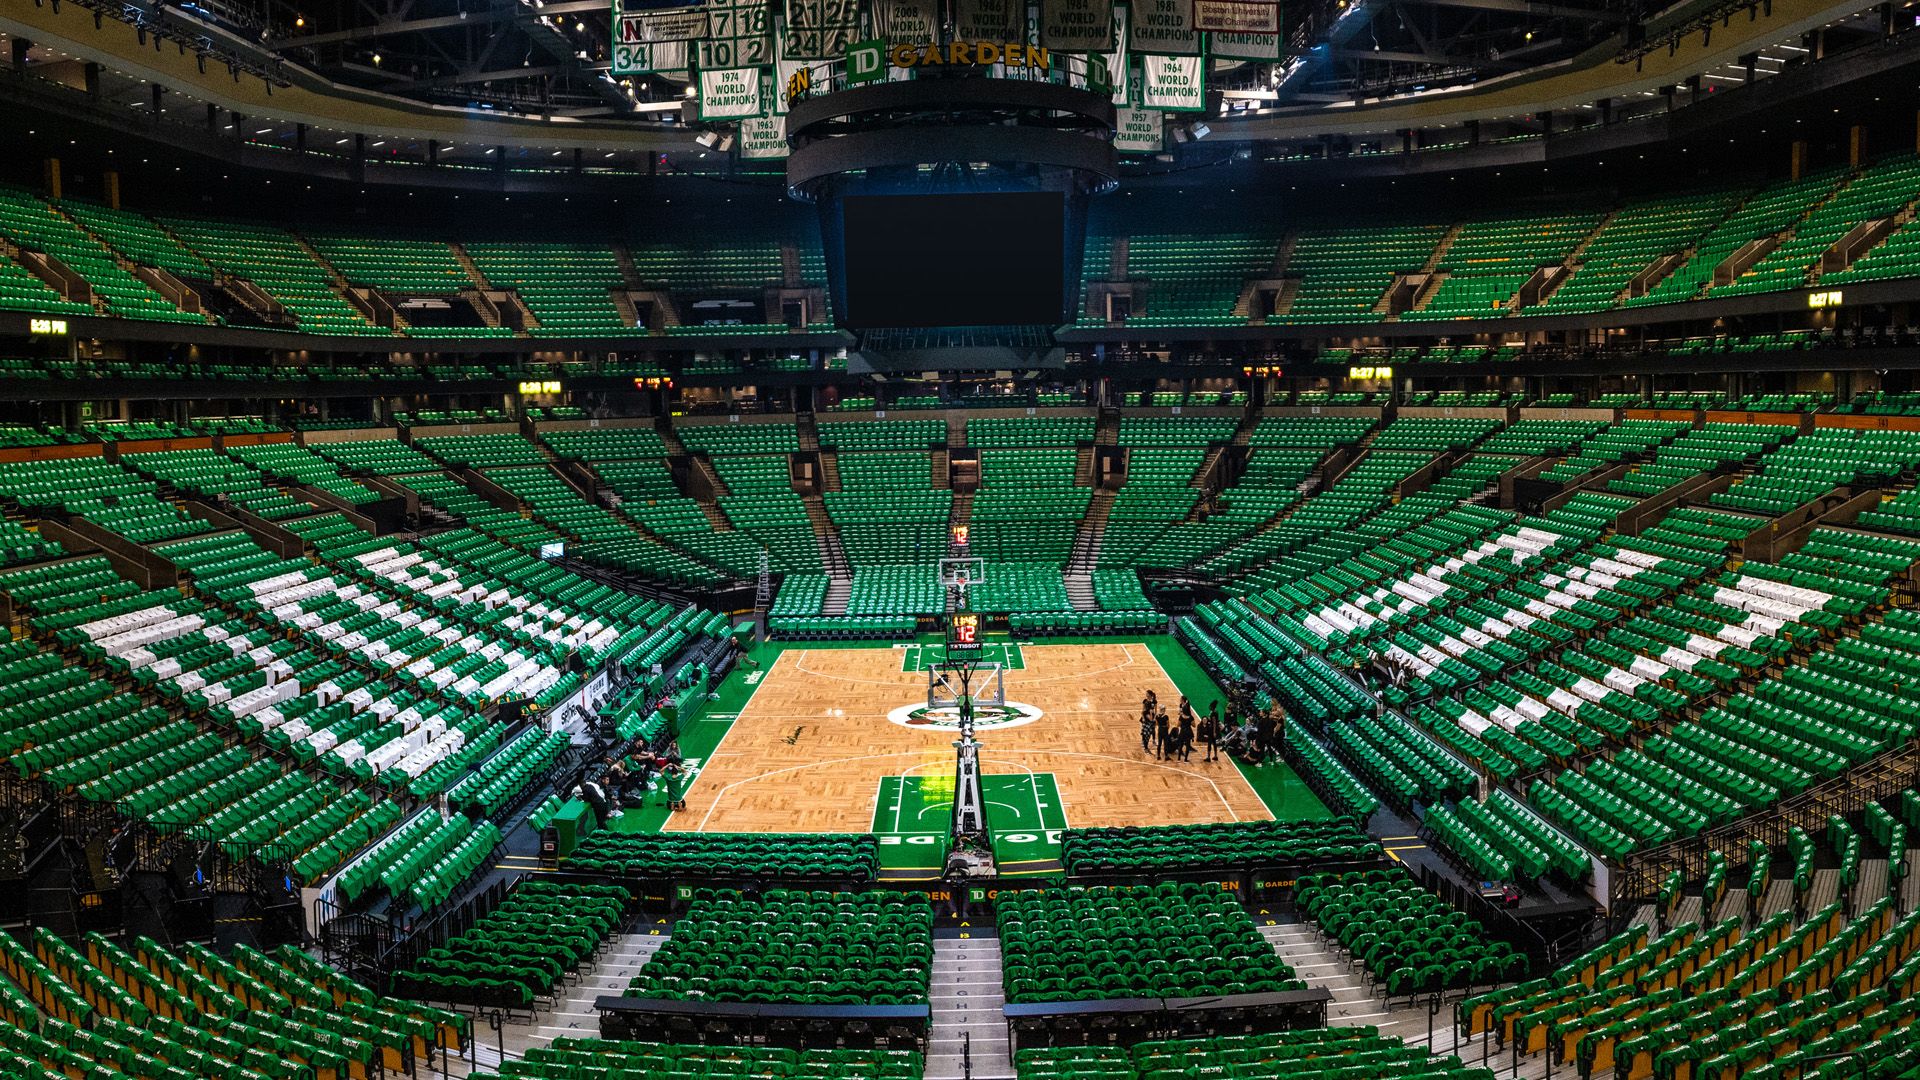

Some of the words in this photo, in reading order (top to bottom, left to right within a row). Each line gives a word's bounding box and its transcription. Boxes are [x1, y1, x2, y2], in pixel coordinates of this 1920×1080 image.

[1155, 0, 1176, 12] 1981
[1203, 6, 1230, 14] Boston
[1233, 7, 1270, 16] University
[789, 3, 818, 25] 21
[826, 2, 856, 24] 25
[896, 7, 918, 18] 2008
[1060, 12, 1095, 24] WORLD
[714, 13, 730, 35] 7
[740, 10, 768, 33] 18
[891, 21, 925, 32] WORLD
[1147, 14, 1183, 27] WORLD
[1225, 18, 1270, 27] Champions
[624, 20, 642, 41] N
[1048, 26, 1107, 38] CHAMPIONS
[1135, 27, 1194, 41] CHAMPIONS
[787, 33, 818, 55] 24
[1217, 33, 1274, 46] CHAMPIONS
[617, 47, 648, 69] 34
[702, 43, 730, 65] 10
[747, 41, 763, 63] 2
[850, 48, 879, 74] TD
[892, 41, 1048, 69] GARDEN
[1163, 63, 1182, 73] 1964
[722, 73, 739, 82] 1974
[1158, 75, 1189, 86] WORLD
[715, 84, 746, 95] WORLD
[1148, 86, 1199, 97] CHAMPIONS
[706, 94, 756, 106] CHAMPIONS
[1131, 113, 1147, 122] 1957
[757, 121, 774, 129] 1963
[1126, 123, 1152, 132] WORLD
[752, 131, 779, 140] WORLD
[1117, 132, 1160, 143] CHAMPIONS
[744, 140, 787, 150] CHAMPIONS
[1829, 291, 1842, 306] PM
[52, 321, 67, 334] PM
[1350, 367, 1375, 379] 5:27
[1376, 367, 1392, 379] PM
[519, 382, 541, 394] 5:26
[543, 381, 561, 393] PM
[954, 617, 978, 626] 11:46
[957, 626, 975, 642] 12
[679, 888, 692, 898] TD
[971, 891, 984, 900] TD
